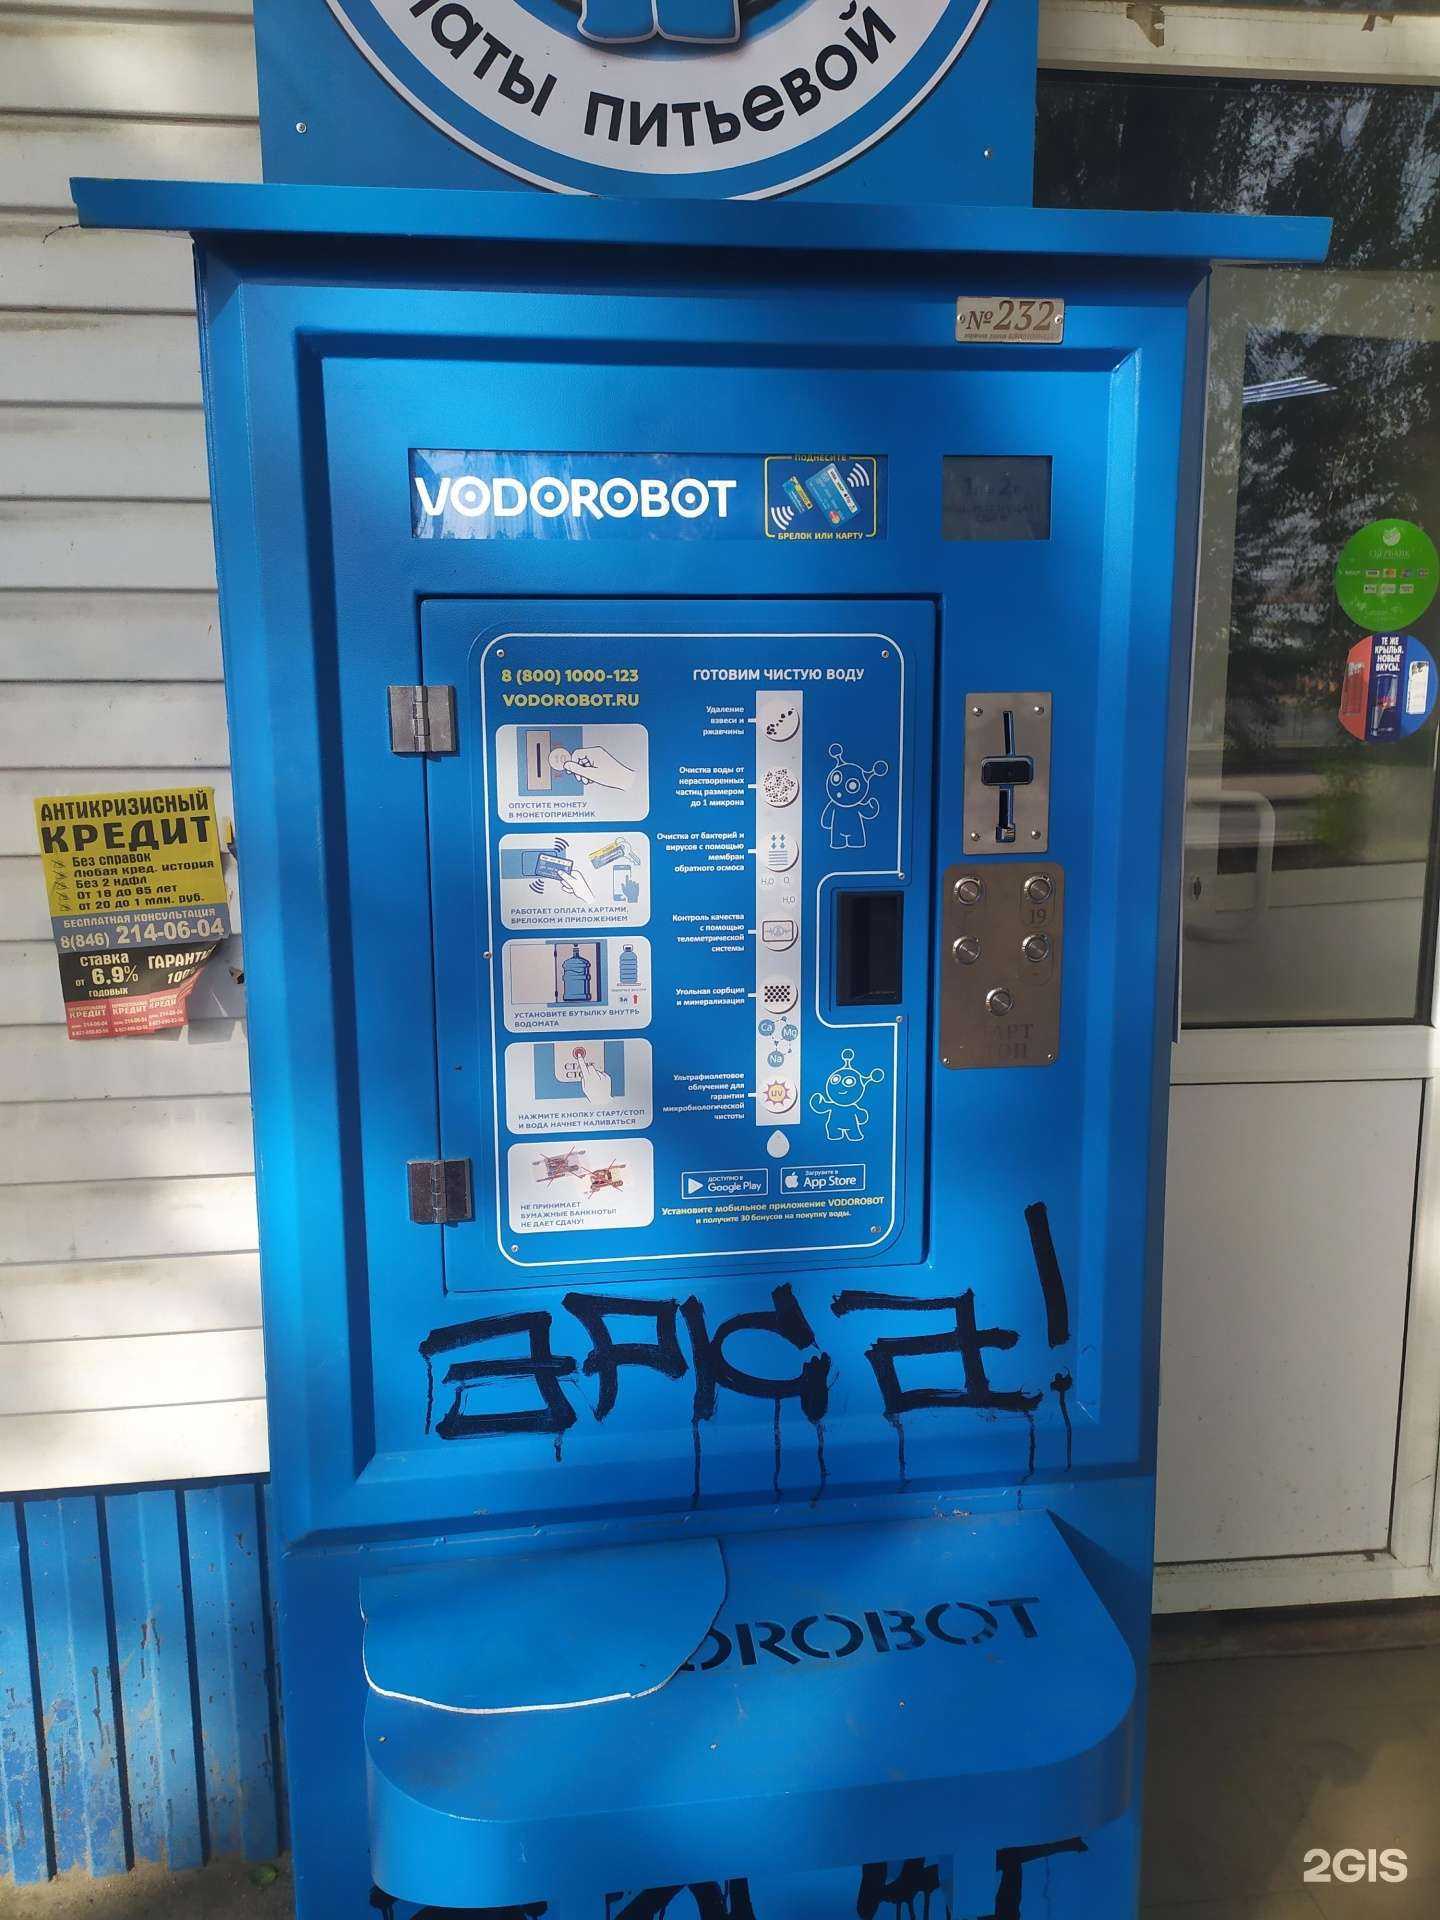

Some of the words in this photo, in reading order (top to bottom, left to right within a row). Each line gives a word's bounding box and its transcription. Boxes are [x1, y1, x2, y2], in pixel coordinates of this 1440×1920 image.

[584, 0, 897, 147] питьевой
[415, 475, 737, 520] VODOROBOT
[778, 532, 812, 540] БРЕЛОК
[1381, 637, 1389, 645] ТЕ
[1390, 637, 1400, 645] ЖЕ
[1375, 645, 1404, 654] КРЫЛЬЯ.
[1376, 663, 1400, 671] ВКУСЫ.
[501, 669, 512, 682] 8
[516, 669, 561, 685] (800)
[565, 669, 639, 683] 1000-123
[693, 669, 759, 681] ГОТОВИМ
[764, 668, 822, 681] ЧИСТУЮ
[826, 668, 864, 682] ВОДУ
[502, 693, 640, 707] VODOROBOT.RU
[706, 706, 744, 715] Удаление
[703, 728, 744, 736] ржавчины
[679, 766, 711, 775] Очистка
[713, 767, 736, 775] воды
[679, 777, 744, 785] нерастворенных
[676, 789, 703, 797] частиц
[704, 788, 744, 797] размером
[41, 789, 209, 822] АНТИКРИЗИСНЫЙ
[553, 801, 587, 809] МОНЕТУ
[690, 800, 701, 808] до
[709, 799, 744, 807] микрона
[516, 811, 596, 819] МОНЕТОПРИЕМНИК
[41, 815, 210, 854] КРЕДИТ
[657, 833, 689, 841] Очистка
[700, 832, 738, 841] бактерий
[666, 844, 698, 852] вирусов
[704, 843, 744, 852] помощью
[72, 855, 96, 867] Без
[98, 853, 152, 867] справок
[708, 853, 744, 862] мембран
[74, 864, 118, 878] Любая
[122, 864, 158, 876] кред.
[162, 860, 215, 873] история
[674, 864, 715, 873] обратного
[716, 864, 744, 872] осмоса
[76, 878, 98, 889] Без
[102, 877, 110, 887] 2
[98, 889, 112, 898] 18
[116, 888, 132, 897] до
[135, 886, 152, 895] 65
[156, 884, 178, 894] лет
[95, 900, 111, 909] 20
[115, 899, 130, 909] до
[511, 907, 551, 915] РАБОТАЕТ
[63, 914, 131, 929] БЕСПЛАТНАЯ
[134, 907, 216, 924] КОНСУЛЬТАЦИЯ
[565, 915, 628, 923] ПРИЛОЖЕНИЕМ
[672, 914, 709, 922] Контроль
[705, 924, 744, 932] помощью
[60, 932, 110, 951] 8(846)
[116, 917, 225, 946] 214-06-04
[677, 935, 744, 943] телеметрической
[75, 978, 85, 987] от
[88, 987, 129, 998] годовых
[675, 988, 711, 996] Угольная
[713, 987, 744, 996] сорбция
[683, 998, 744, 1007] минерализация
[112, 1005, 147, 1016] КРЕДИТ
[514, 1010, 567, 1019] УСТАНОВИТЕ
[569, 1009, 607, 1017] БУТЫЛКУ
[609, 1008, 640, 1016] ВНУТРЬ
[514, 1020, 560, 1028] ВОДОМАТА
[770, 1055, 782, 1063] Na
[673, 1073, 744, 1082] Ультрафиолетовое
[688, 1083, 728, 1092] облучение
[729, 1082, 744, 1091] для
[710, 1093, 744, 1101] гарантии
[663, 1102, 744, 1112] микробиологической
[561, 1111, 594, 1119] КНОПКУ
[596, 1109, 645, 1118] СТАРТ/СТОП
[526, 1121, 549, 1129] ВОДА
[583, 1118, 636, 1127] НАЛИВАТЬСЯ
[708, 1181, 741, 1193] Google
[743, 1179, 762, 1191] Play
[804, 1176, 827, 1189] App
[828, 1174, 857, 1186] Store
[532, 1202, 581, 1210] ПРИНИМАЕТ
[661, 1206, 713, 1216] Установите
[715, 1203, 766, 1213] мобильное
[769, 1200, 825, 1211] приложение
[828, 1196, 885, 1207] VODOROBOT
[521, 1210, 568, 1219] БУМАЖНЫЕ
[702, 1216, 739, 1226] получите
[741, 1214, 750, 1222] 30
[751, 1213, 783, 1222] бонусов
[795, 1211, 827, 1221] покупку
[828, 1210, 851, 1218] воды.
[532, 1220, 554, 1228] ДАЕТ
